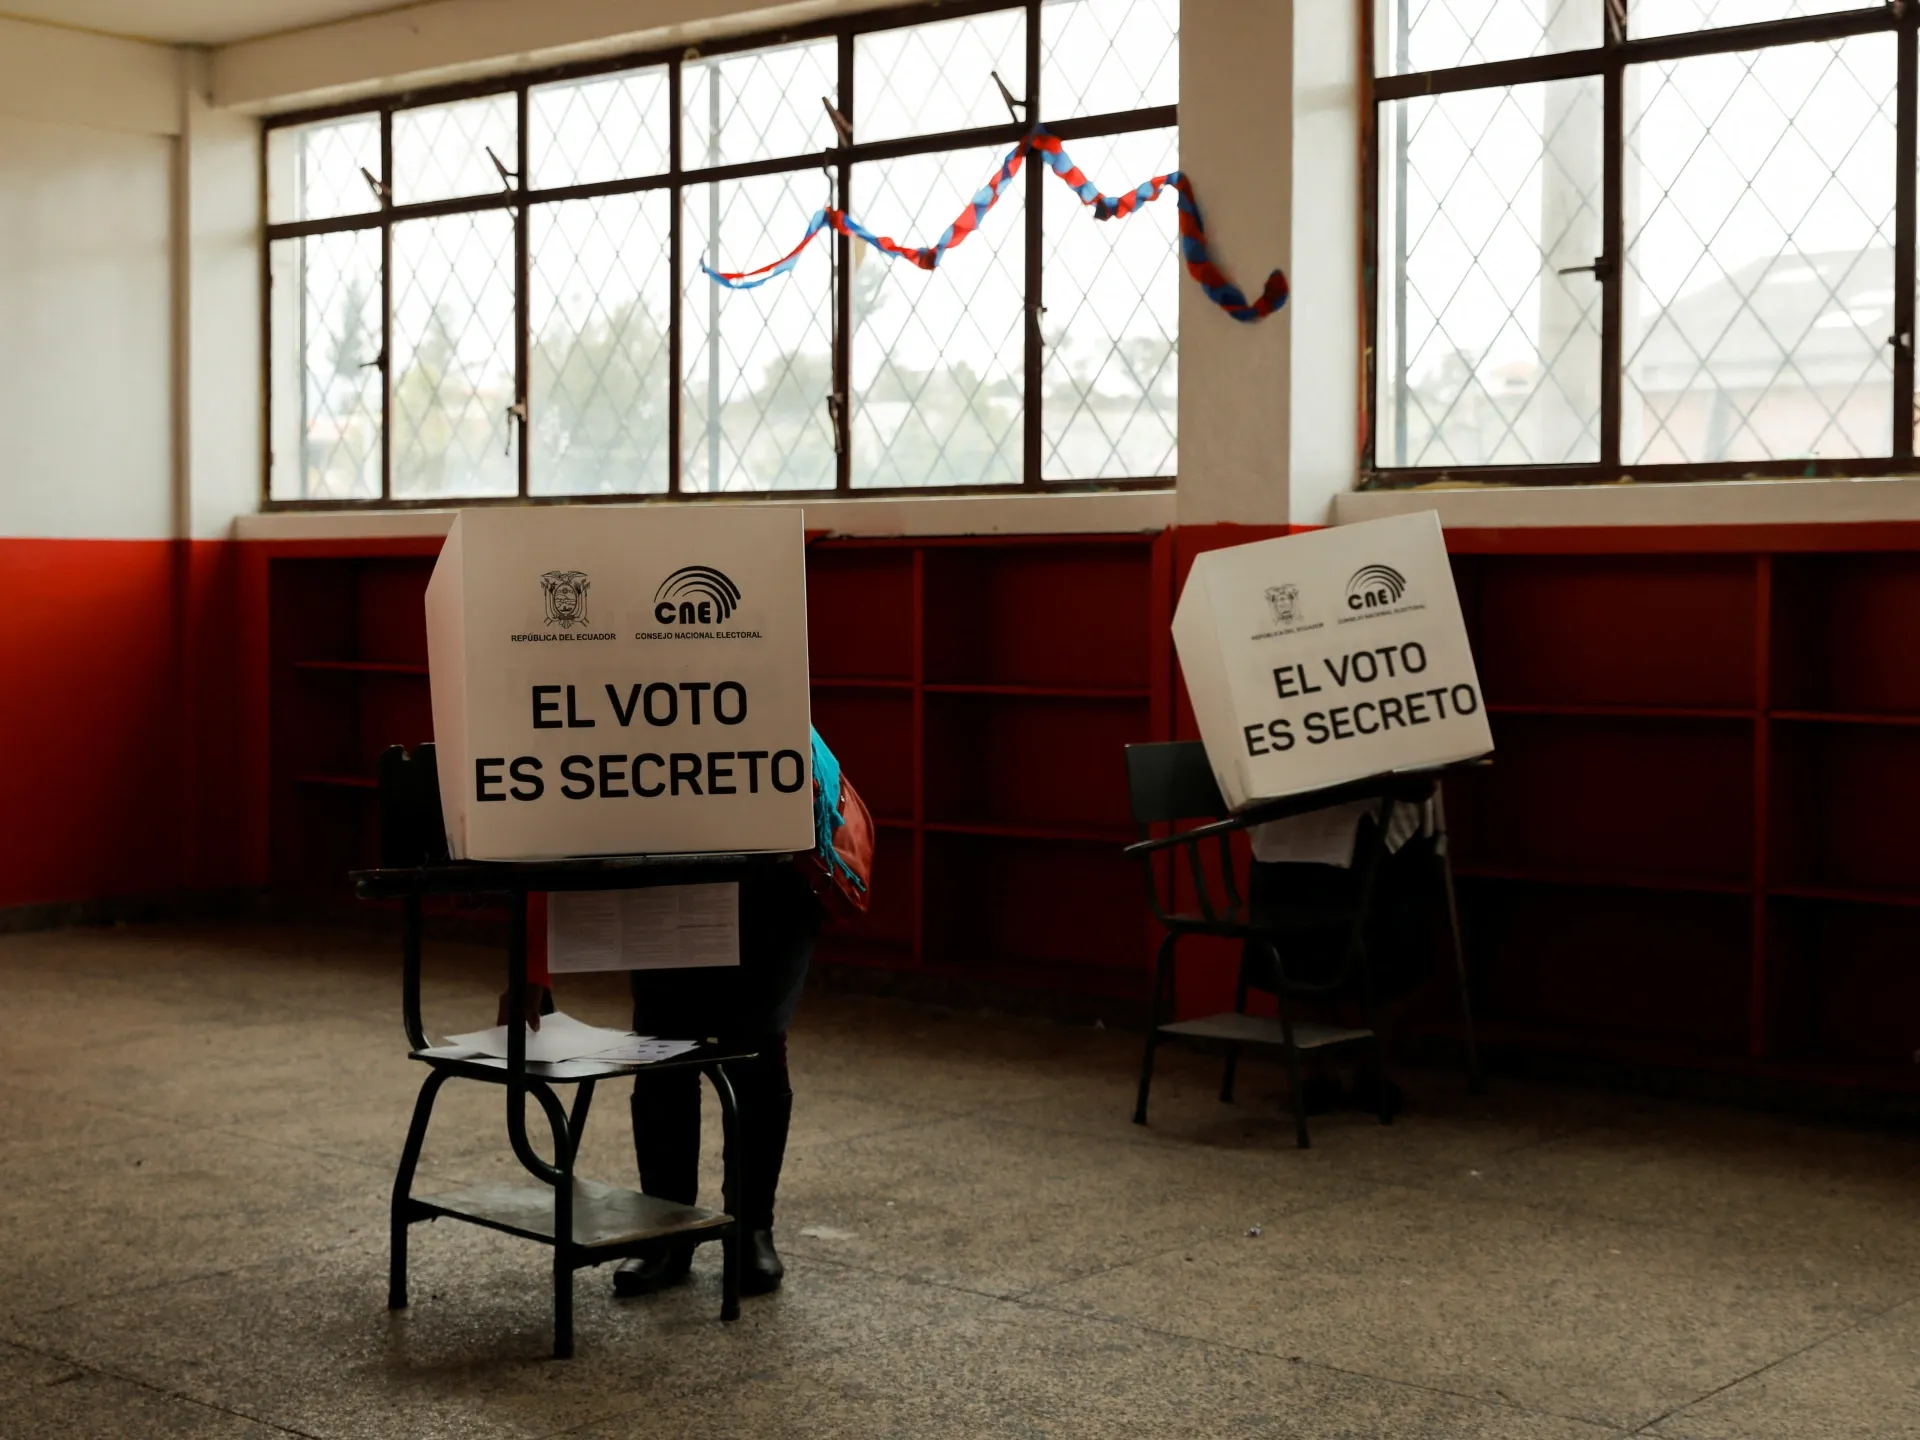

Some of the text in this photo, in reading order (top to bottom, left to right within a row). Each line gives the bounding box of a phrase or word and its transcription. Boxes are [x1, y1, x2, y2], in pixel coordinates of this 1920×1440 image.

[510, 632, 617, 643] REPÚBLICA DEL ECUADOR
[634, 630, 763, 640] CONSEJO NACIONAL ELECTORAL
[1272, 641, 1428, 700] EL VOTO
[532, 680, 748, 730] EL VOTO
[1243, 683, 1479, 757] ES SECRETO
[475, 749, 806, 803] ES SECRETO
